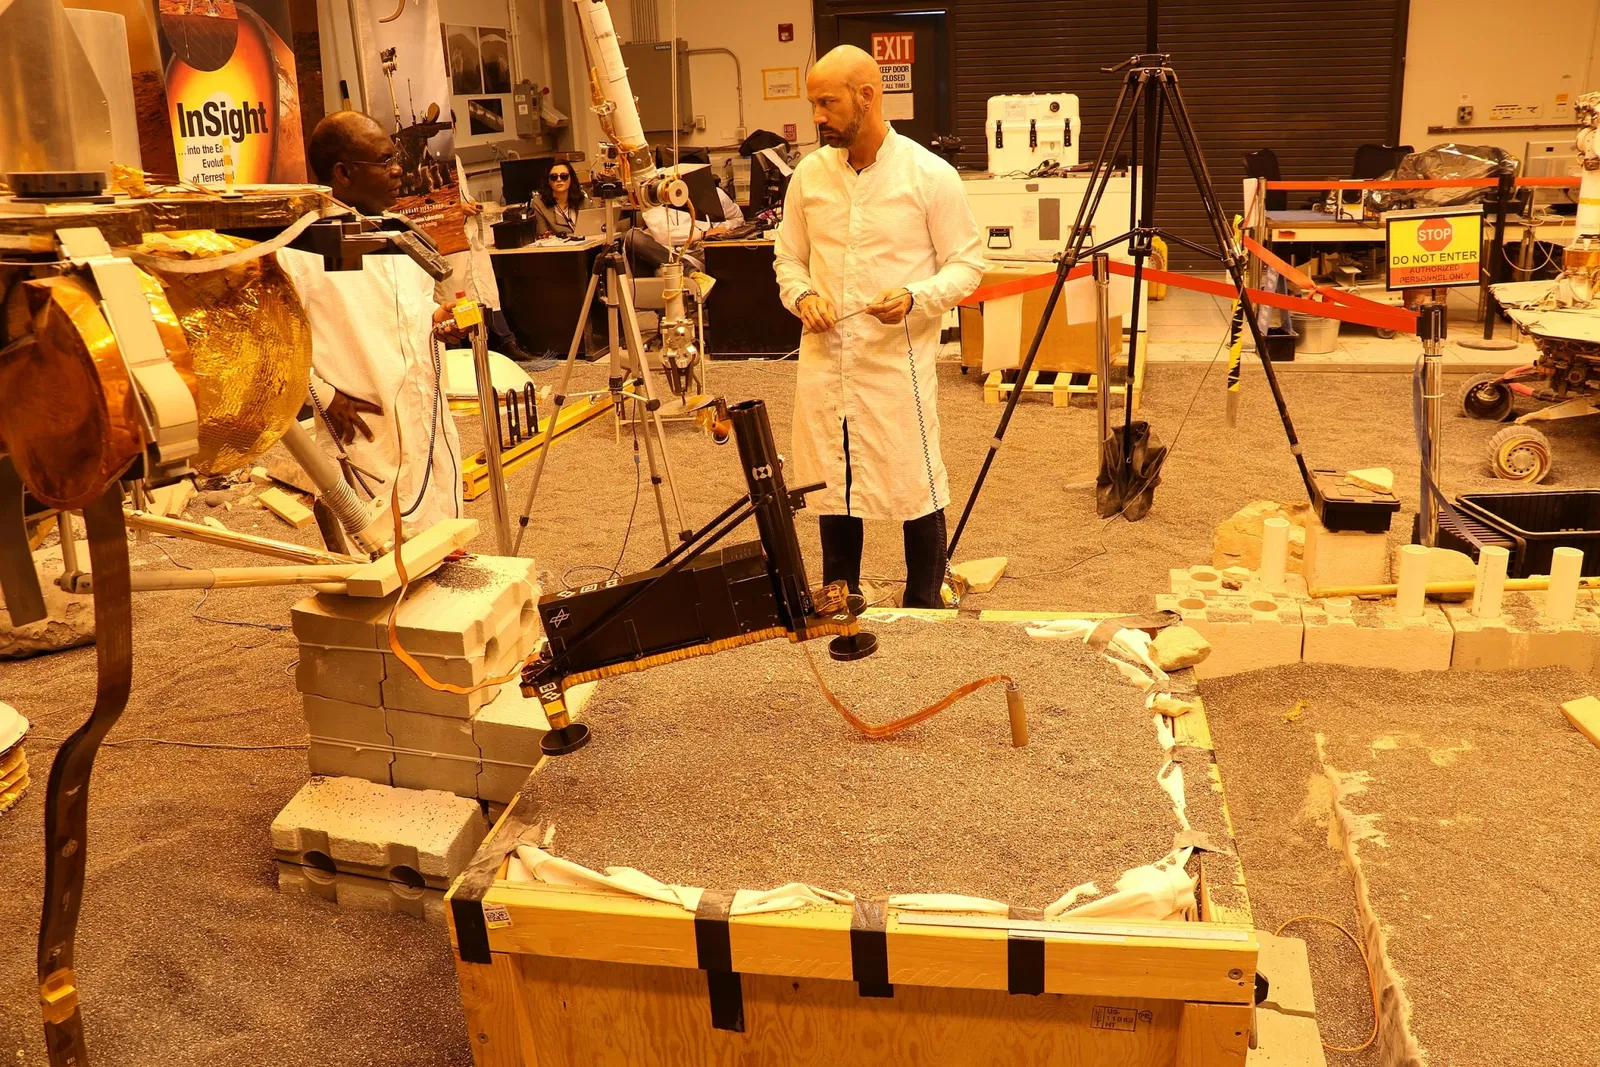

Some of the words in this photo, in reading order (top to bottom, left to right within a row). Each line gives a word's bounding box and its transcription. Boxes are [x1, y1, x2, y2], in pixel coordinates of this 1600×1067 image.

[873, 36, 912, 60] EXIT
[893, 65, 909, 73] DOOR
[882, 74, 906, 82] CLOSED
[176, 101, 269, 144] InSight
[202, 144, 214, 154] the
[202, 157, 233, 168] Evolutn
[192, 174, 200, 183] of
[201, 171, 235, 182] Terrestl
[1418, 228, 1451, 241] STOP
[1392, 255, 1409, 265] DO
[1412, 253, 1436, 264] NOT
[1439, 250, 1477, 262] ENTER
[1409, 264, 1460, 274] AUTHORIZED
[1400, 274, 1447, 284] PERSONNEL
[1449, 272, 1471, 281] ONLY
